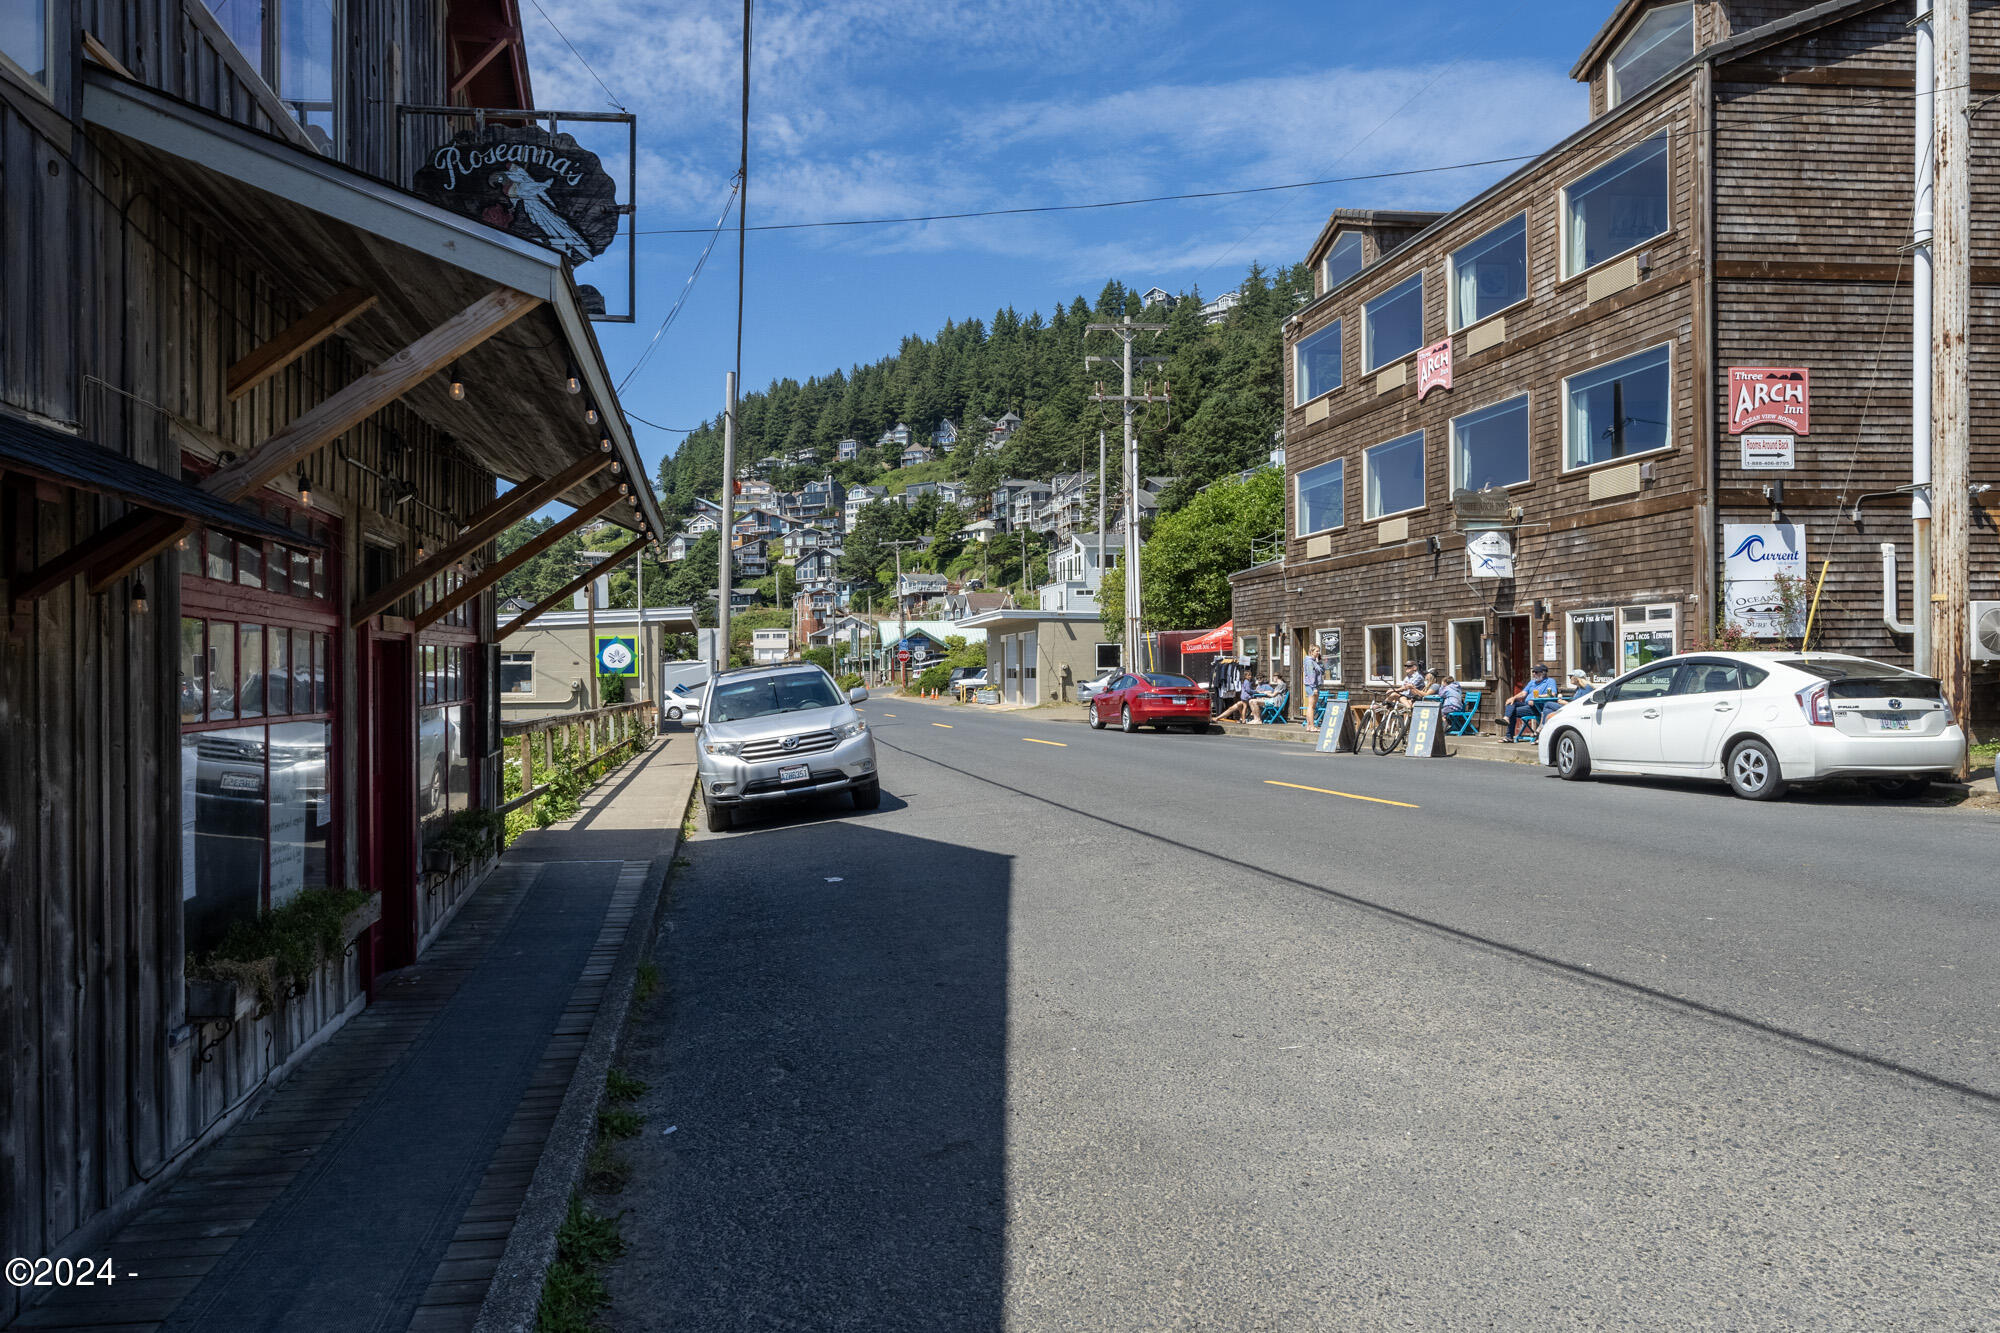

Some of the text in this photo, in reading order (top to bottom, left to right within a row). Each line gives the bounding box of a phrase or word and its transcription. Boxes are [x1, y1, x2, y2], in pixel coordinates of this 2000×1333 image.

[434, 142, 584, 190] Roseanna's
[1420, 352, 1448, 391] ARCH
[1734, 371, 1763, 380] Three
[1734, 383, 1804, 423] ARCH
[1784, 404, 1804, 414] Inn
[1777, 414, 1799, 427] ROOMS
[1746, 440, 1789, 449] Rooms Around Back
[1747, 538, 1800, 562] Current
[1635, 632, 1650, 640] TACOS
[1322, 705, 1339, 750] SURF
[1413, 709, 1430, 755] SHOP
